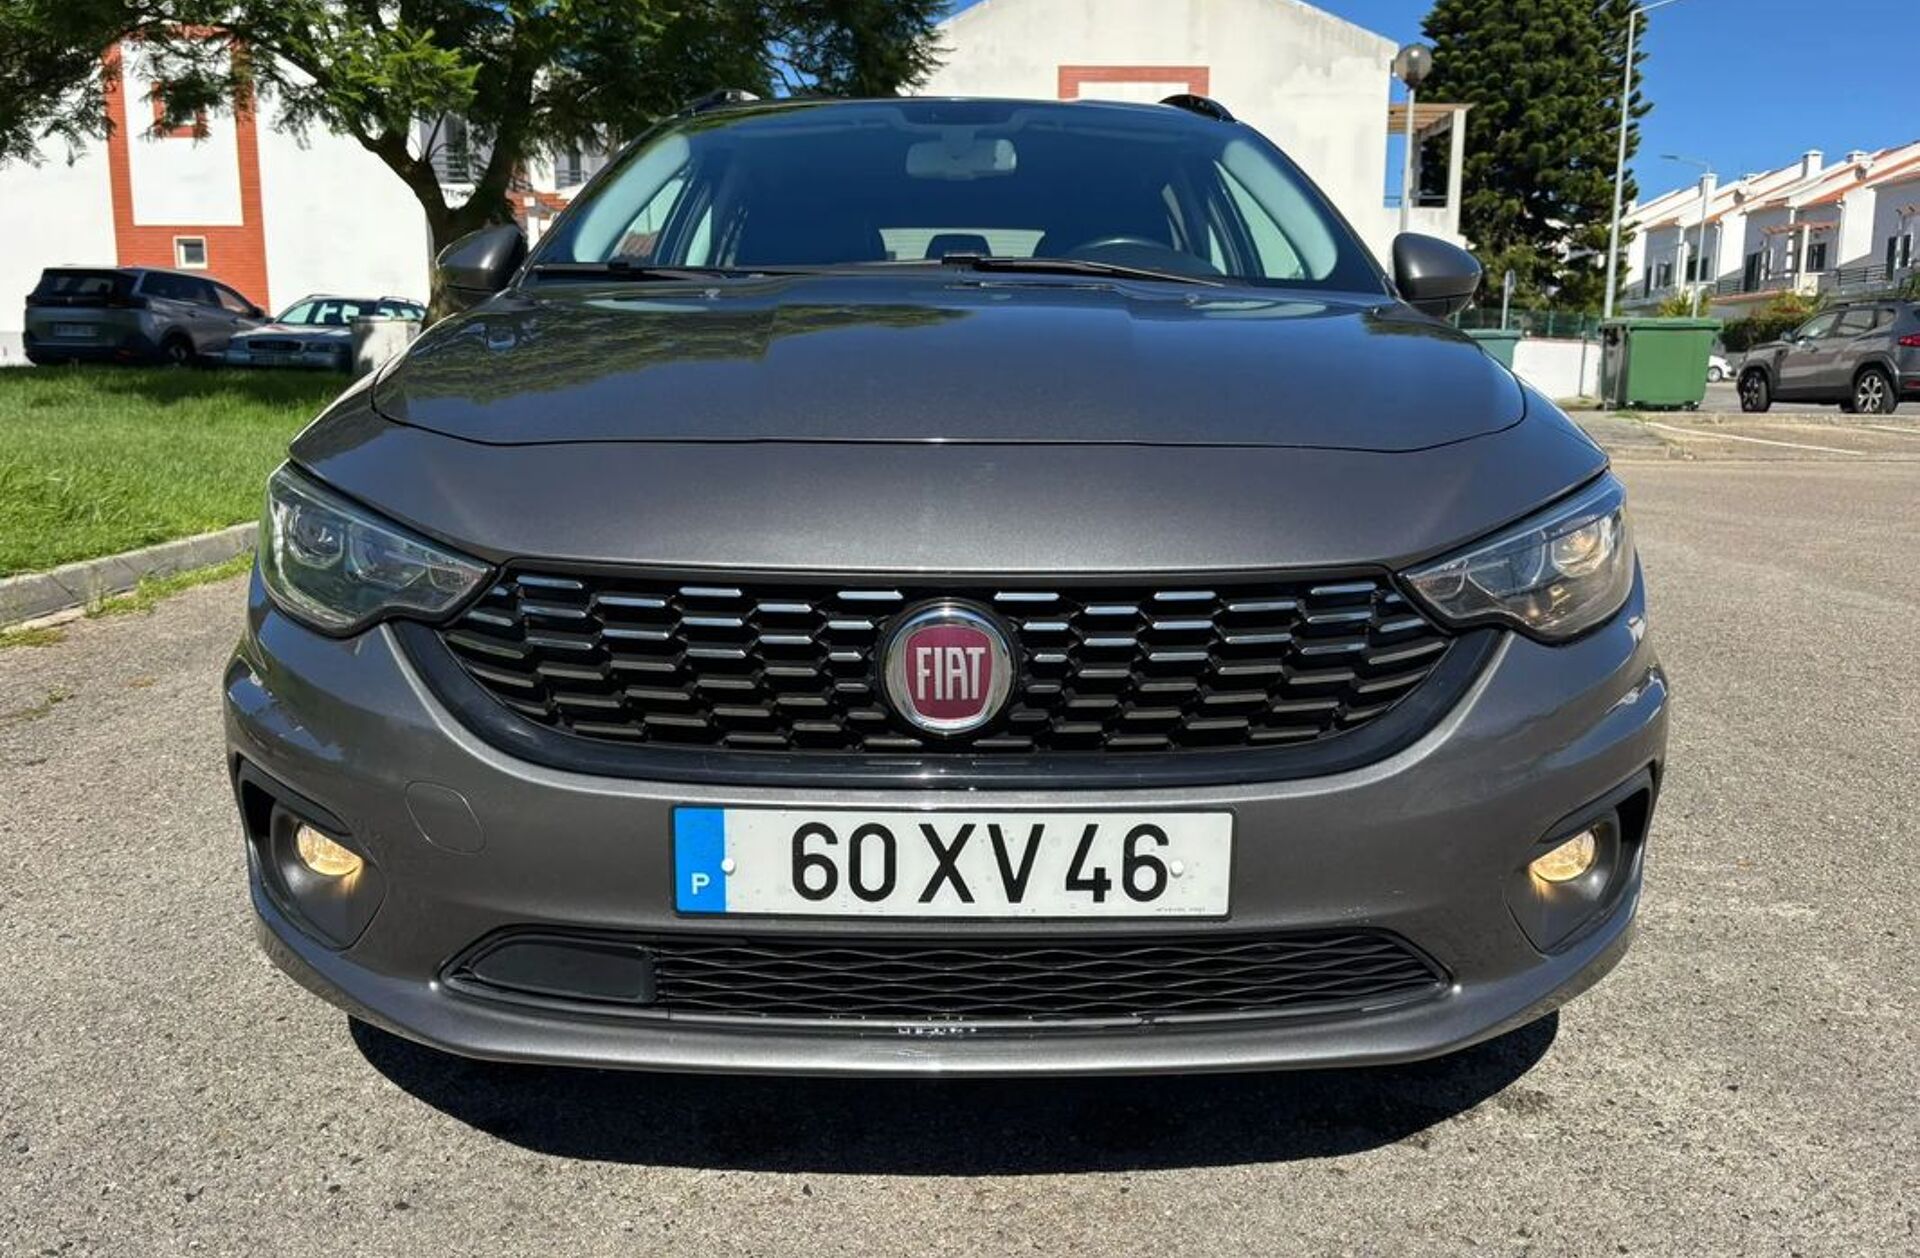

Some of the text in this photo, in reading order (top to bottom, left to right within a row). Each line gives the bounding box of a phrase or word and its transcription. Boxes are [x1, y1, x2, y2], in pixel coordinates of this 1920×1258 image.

[916, 646, 986, 701] FIAT
[691, 873, 710, 894] P
[791, 821, 1170, 904] 60 XV 46
